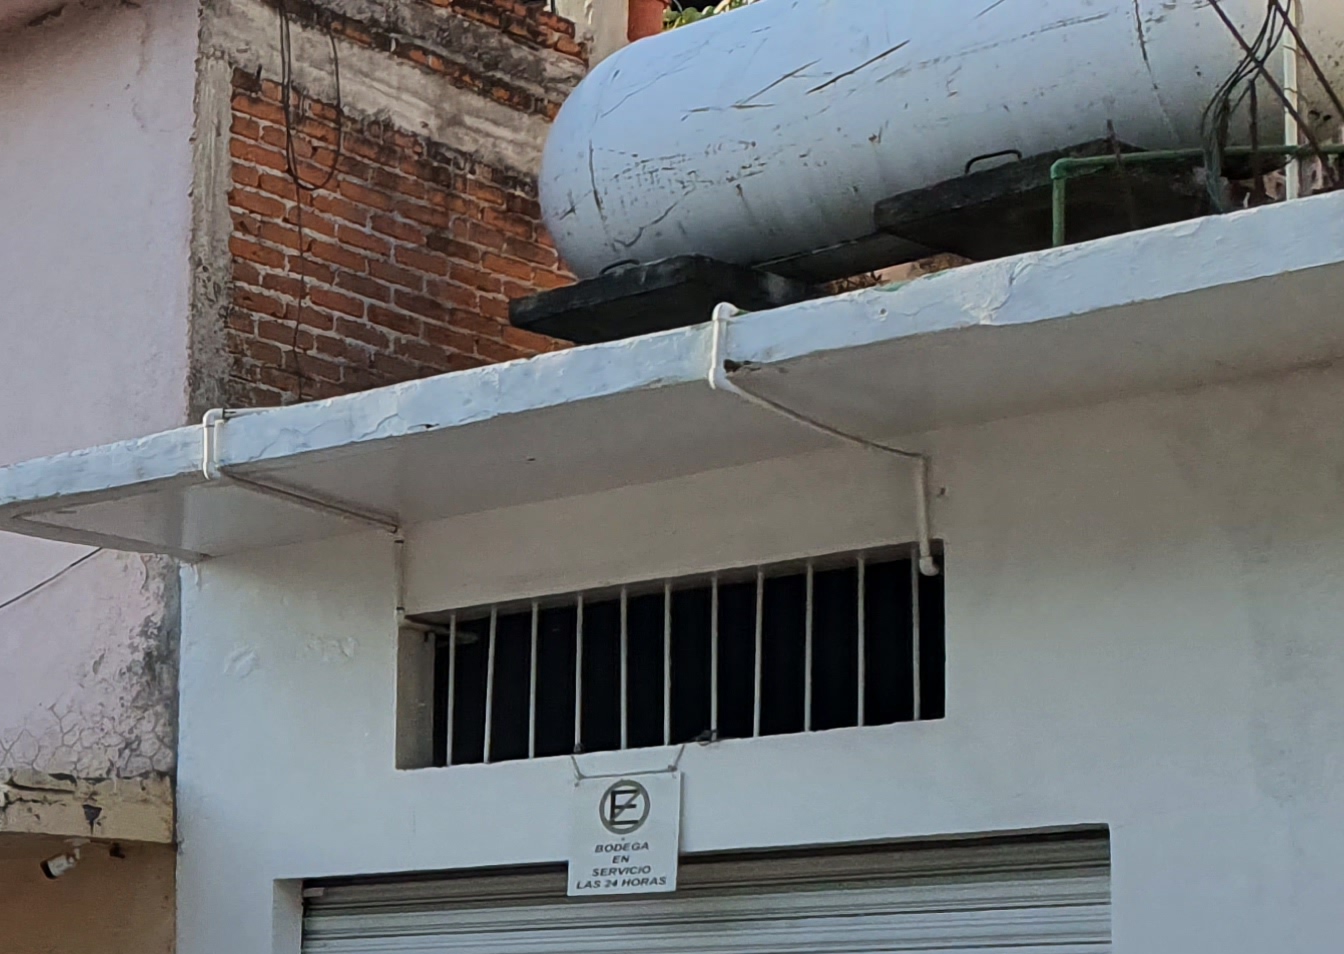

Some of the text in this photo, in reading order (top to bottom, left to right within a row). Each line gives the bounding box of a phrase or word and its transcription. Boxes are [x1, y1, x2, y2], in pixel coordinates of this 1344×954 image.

[594, 841, 650, 853] BODEGA
[612, 855, 630, 864] EN
[592, 865, 651, 877] SERVICIO
[576, 876, 666, 890] LAS 24 HORAS
